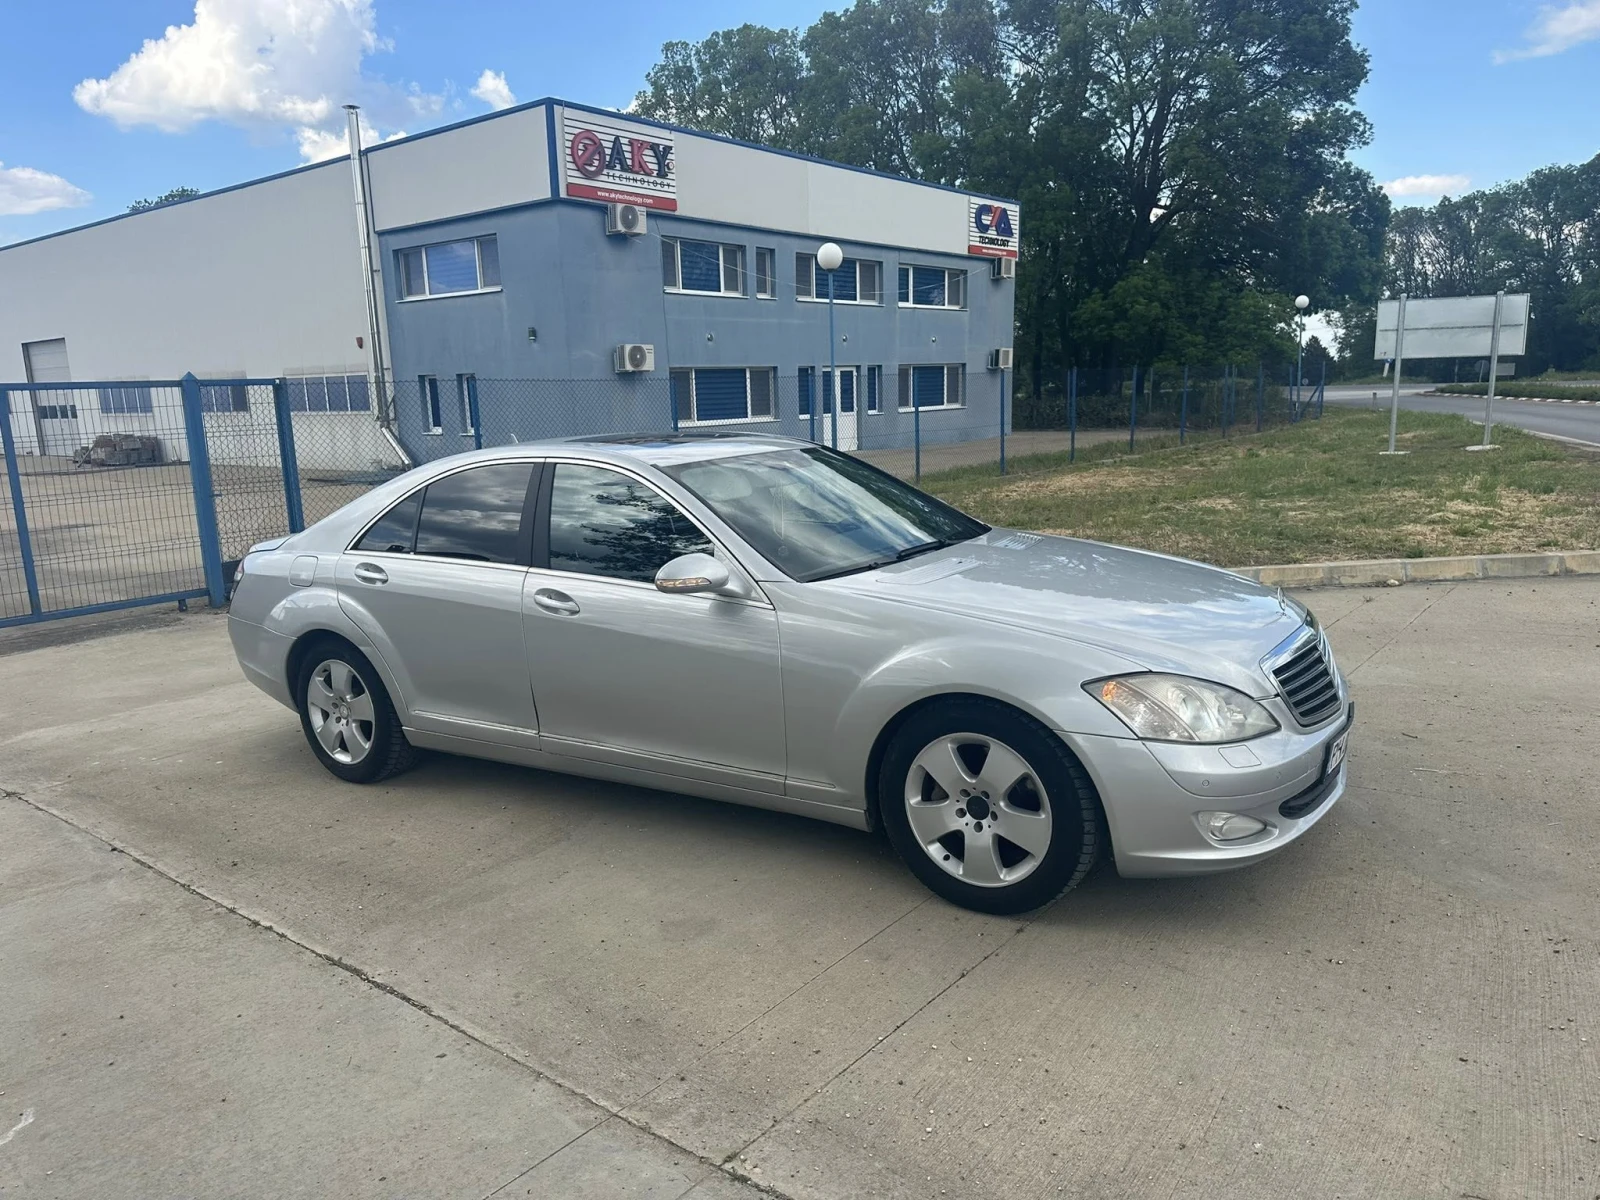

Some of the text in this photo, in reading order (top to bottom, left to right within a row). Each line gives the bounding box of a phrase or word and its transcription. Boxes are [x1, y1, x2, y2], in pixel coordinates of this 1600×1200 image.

[606, 135, 673, 178] AKY
[606, 171, 671, 190] TECHNOLOGY
[597, 190, 654, 204] www.akytechnology.com
[979, 235, 1010, 248] TECHNOLOGY
